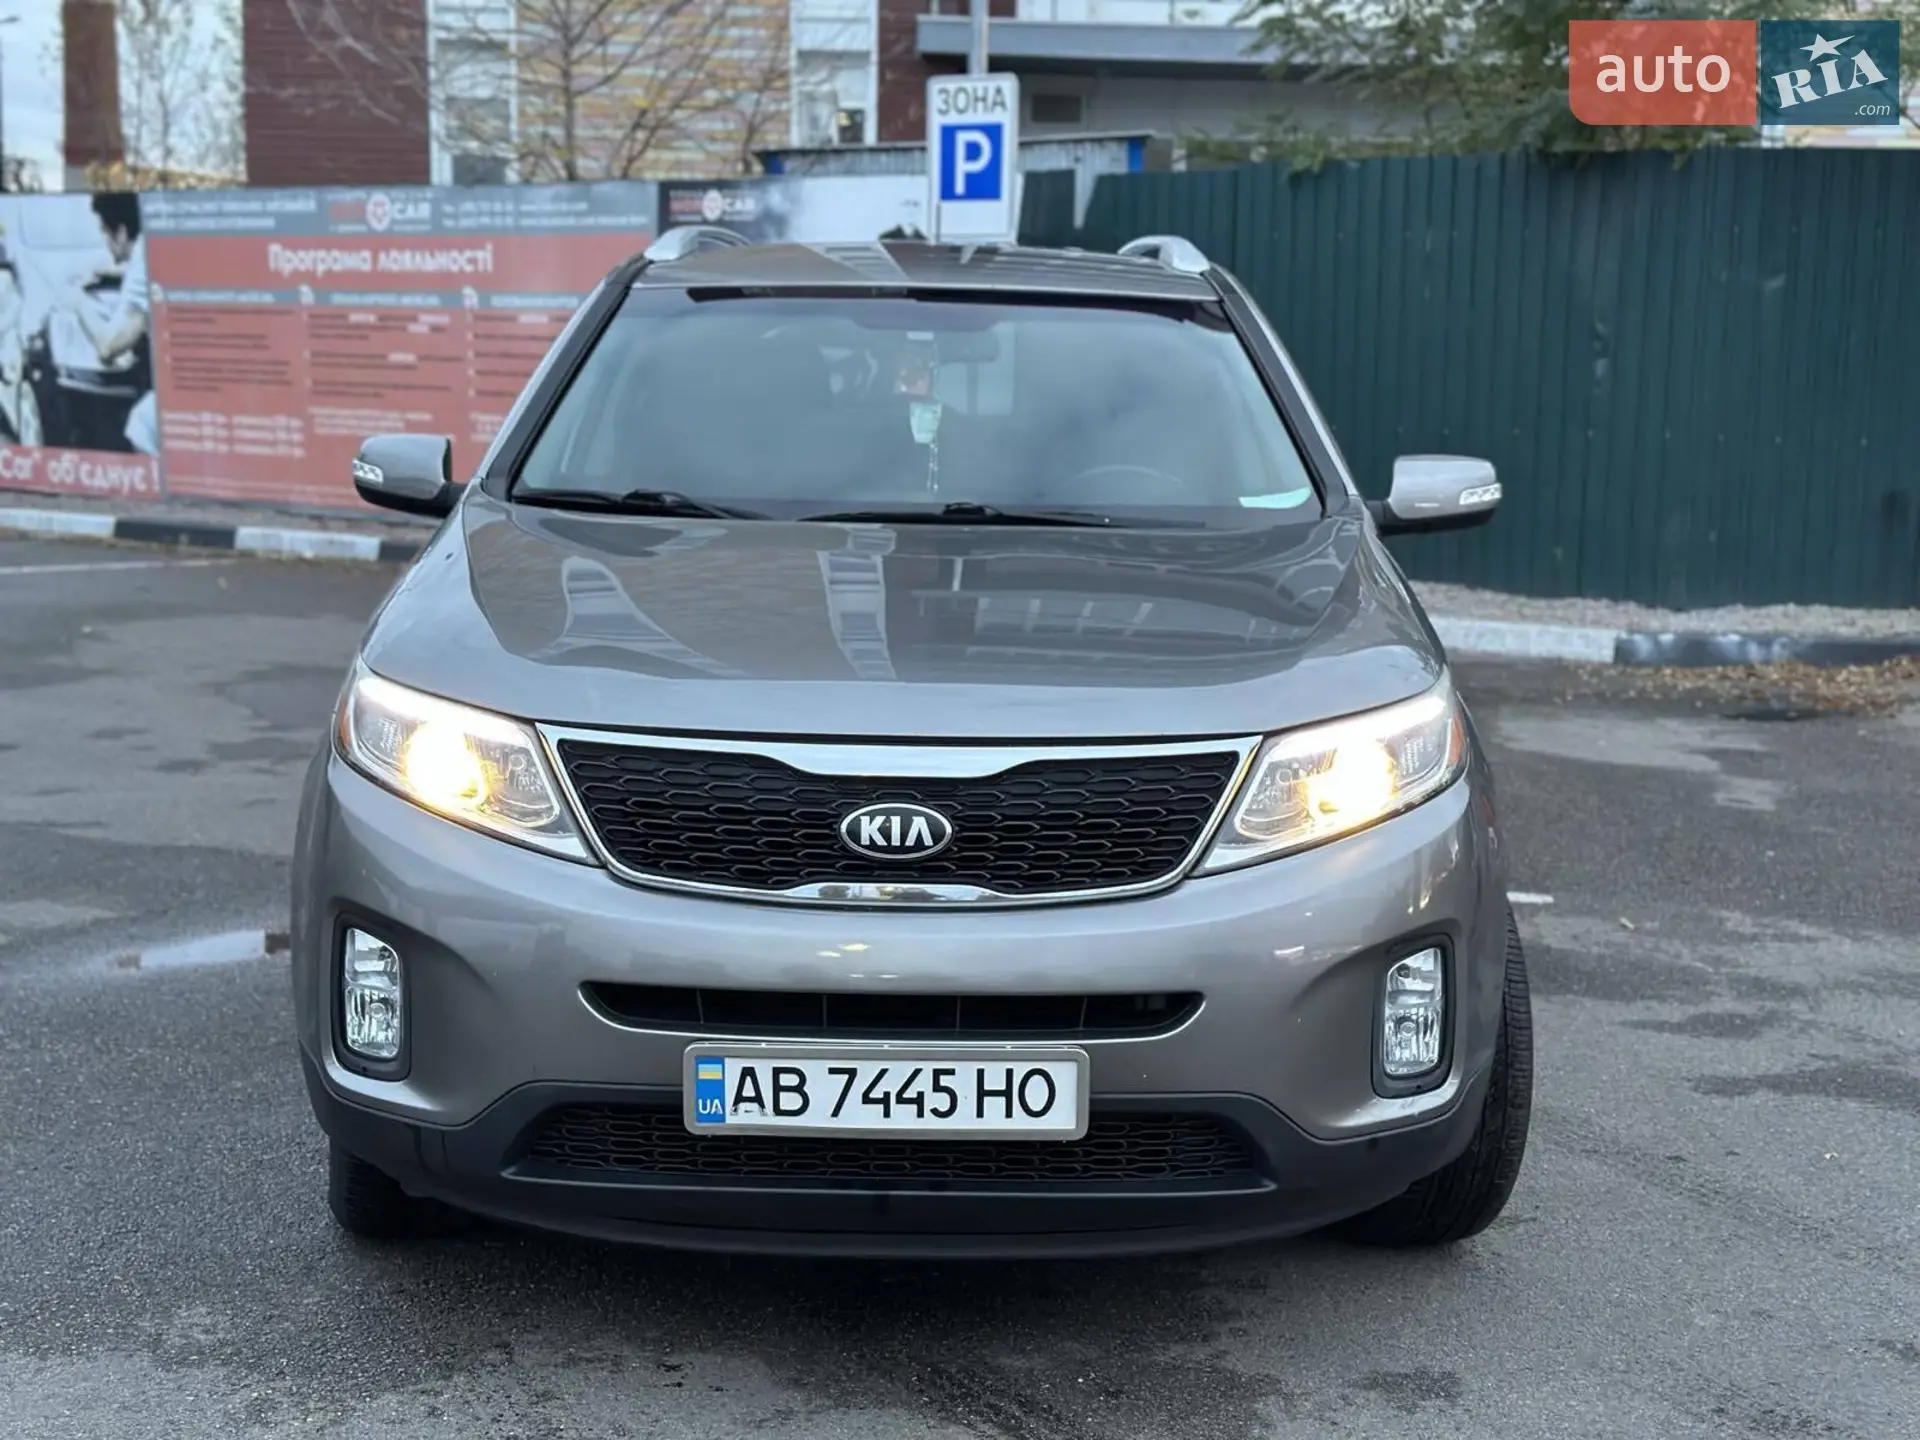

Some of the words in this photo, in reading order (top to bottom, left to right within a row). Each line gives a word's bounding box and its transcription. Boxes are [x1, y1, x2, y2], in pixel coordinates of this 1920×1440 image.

[937, 86, 1008, 115] ЗОНА
[954, 129, 992, 196] P
[267, 243, 372, 278] Програма
[378, 242, 494, 273] лояльності
[860, 815, 934, 846] KIA
[699, 1098, 723, 1115] UA
[730, 1066, 810, 1117] AB
[828, 1067, 958, 1118] 7445
[975, 1067, 1056, 1118] HO
